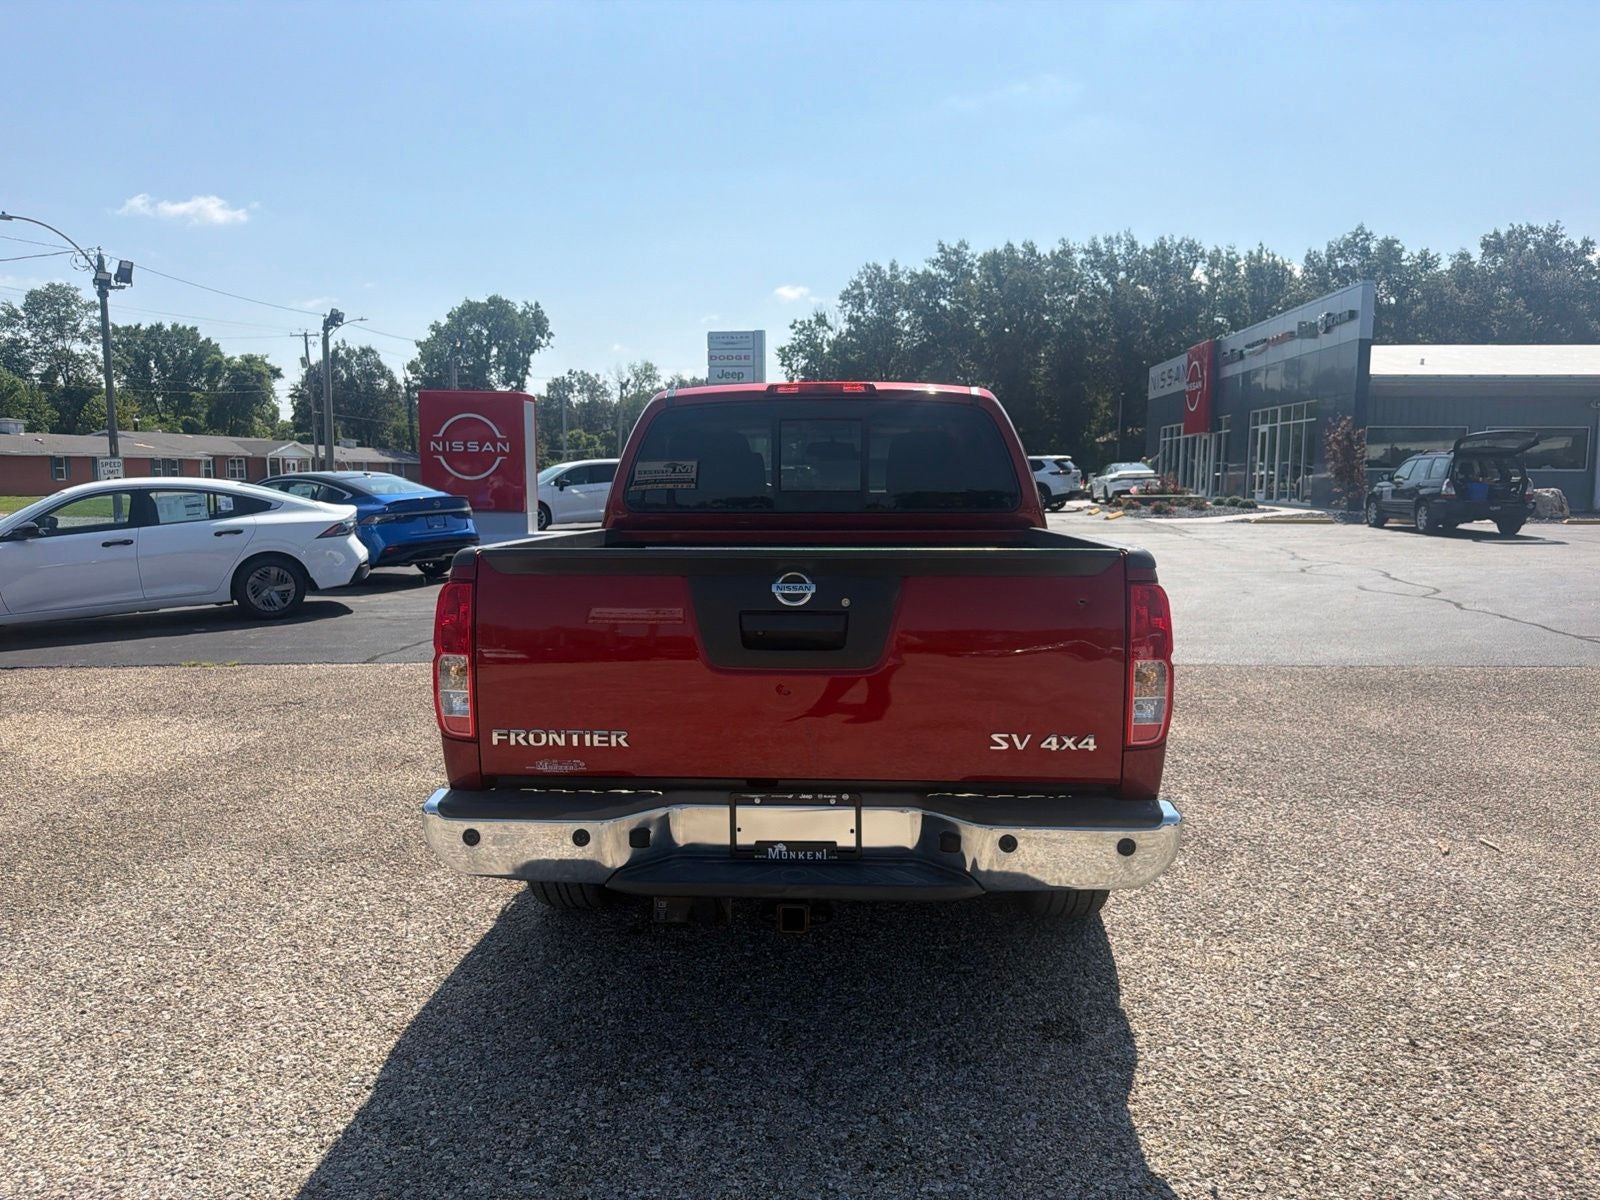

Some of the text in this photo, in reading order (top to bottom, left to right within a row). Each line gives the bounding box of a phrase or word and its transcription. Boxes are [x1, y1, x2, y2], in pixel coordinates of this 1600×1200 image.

[716, 369, 745, 381] Jeep
[430, 440, 510, 453] NISSAN
[100, 461, 122, 469] SPEED
[102, 468, 119, 476] LIMIT
[775, 584, 812, 592] NISSAN
[491, 728, 630, 748] FRONTIER
[989, 733, 1032, 750] SV
